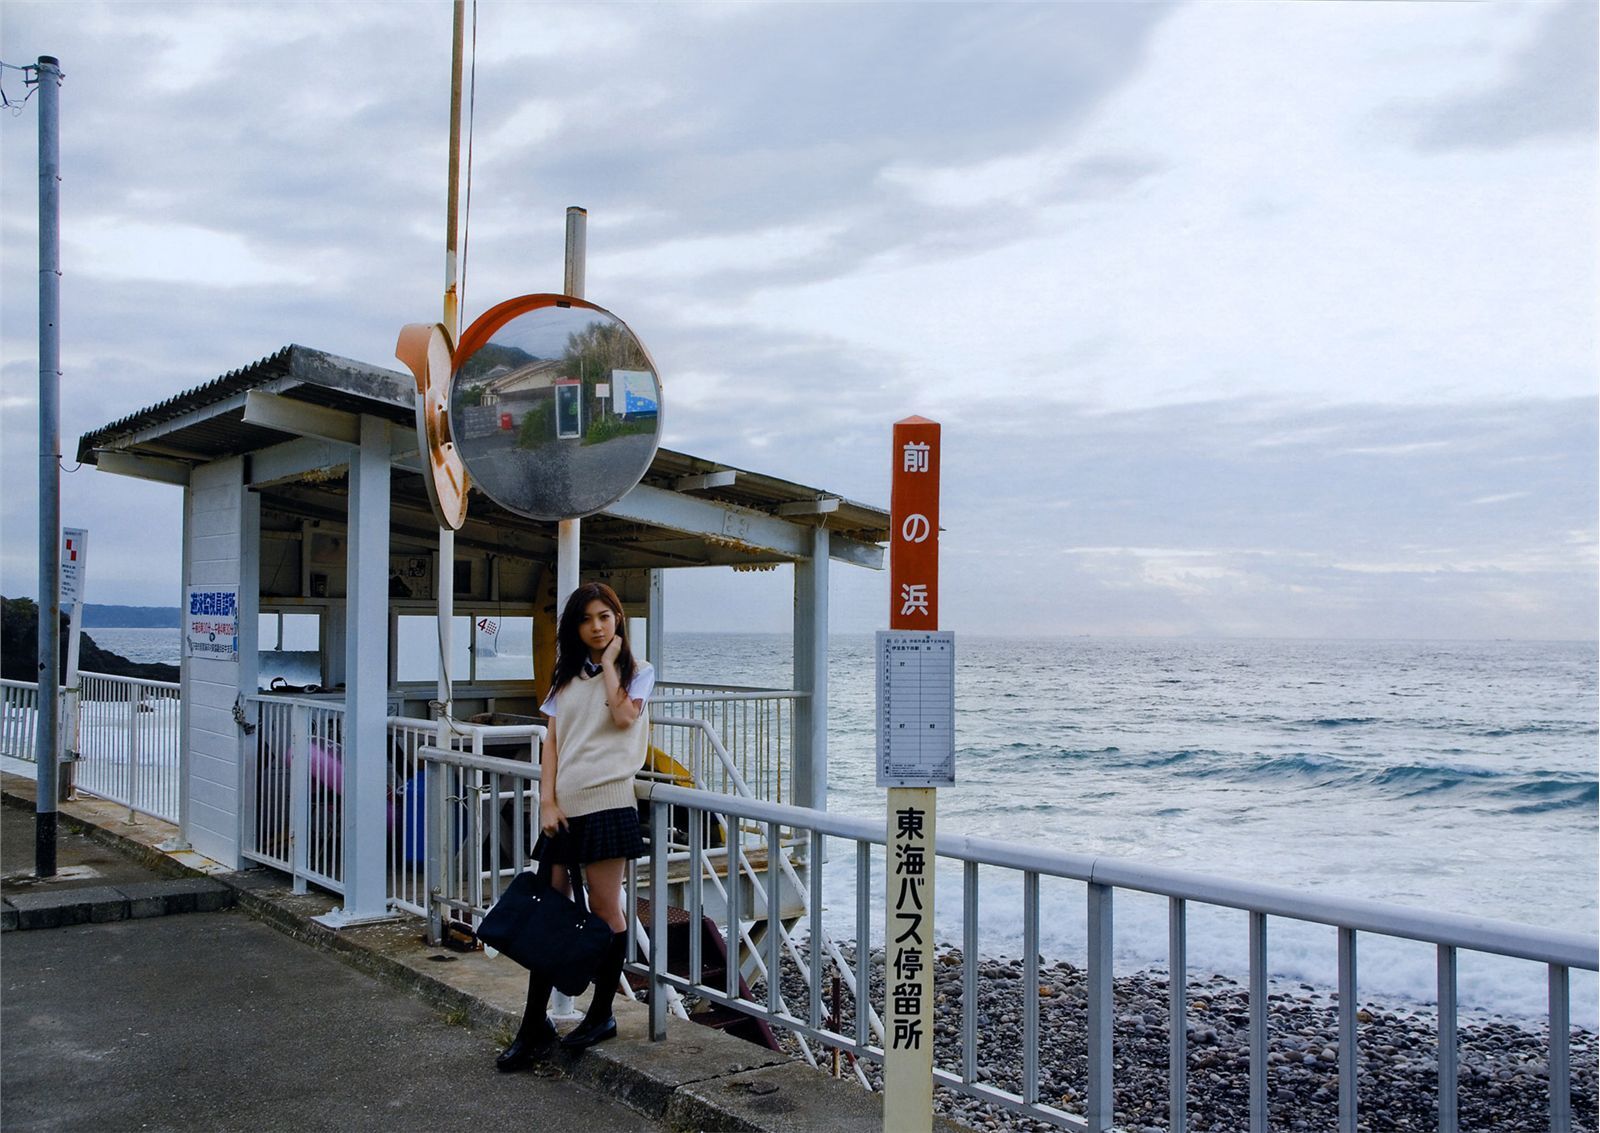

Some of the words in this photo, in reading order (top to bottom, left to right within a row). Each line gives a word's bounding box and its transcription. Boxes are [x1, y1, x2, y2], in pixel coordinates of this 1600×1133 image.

[901, 441, 930, 615] 前の浜
[892, 806, 926, 1050] 東海バス停留所
